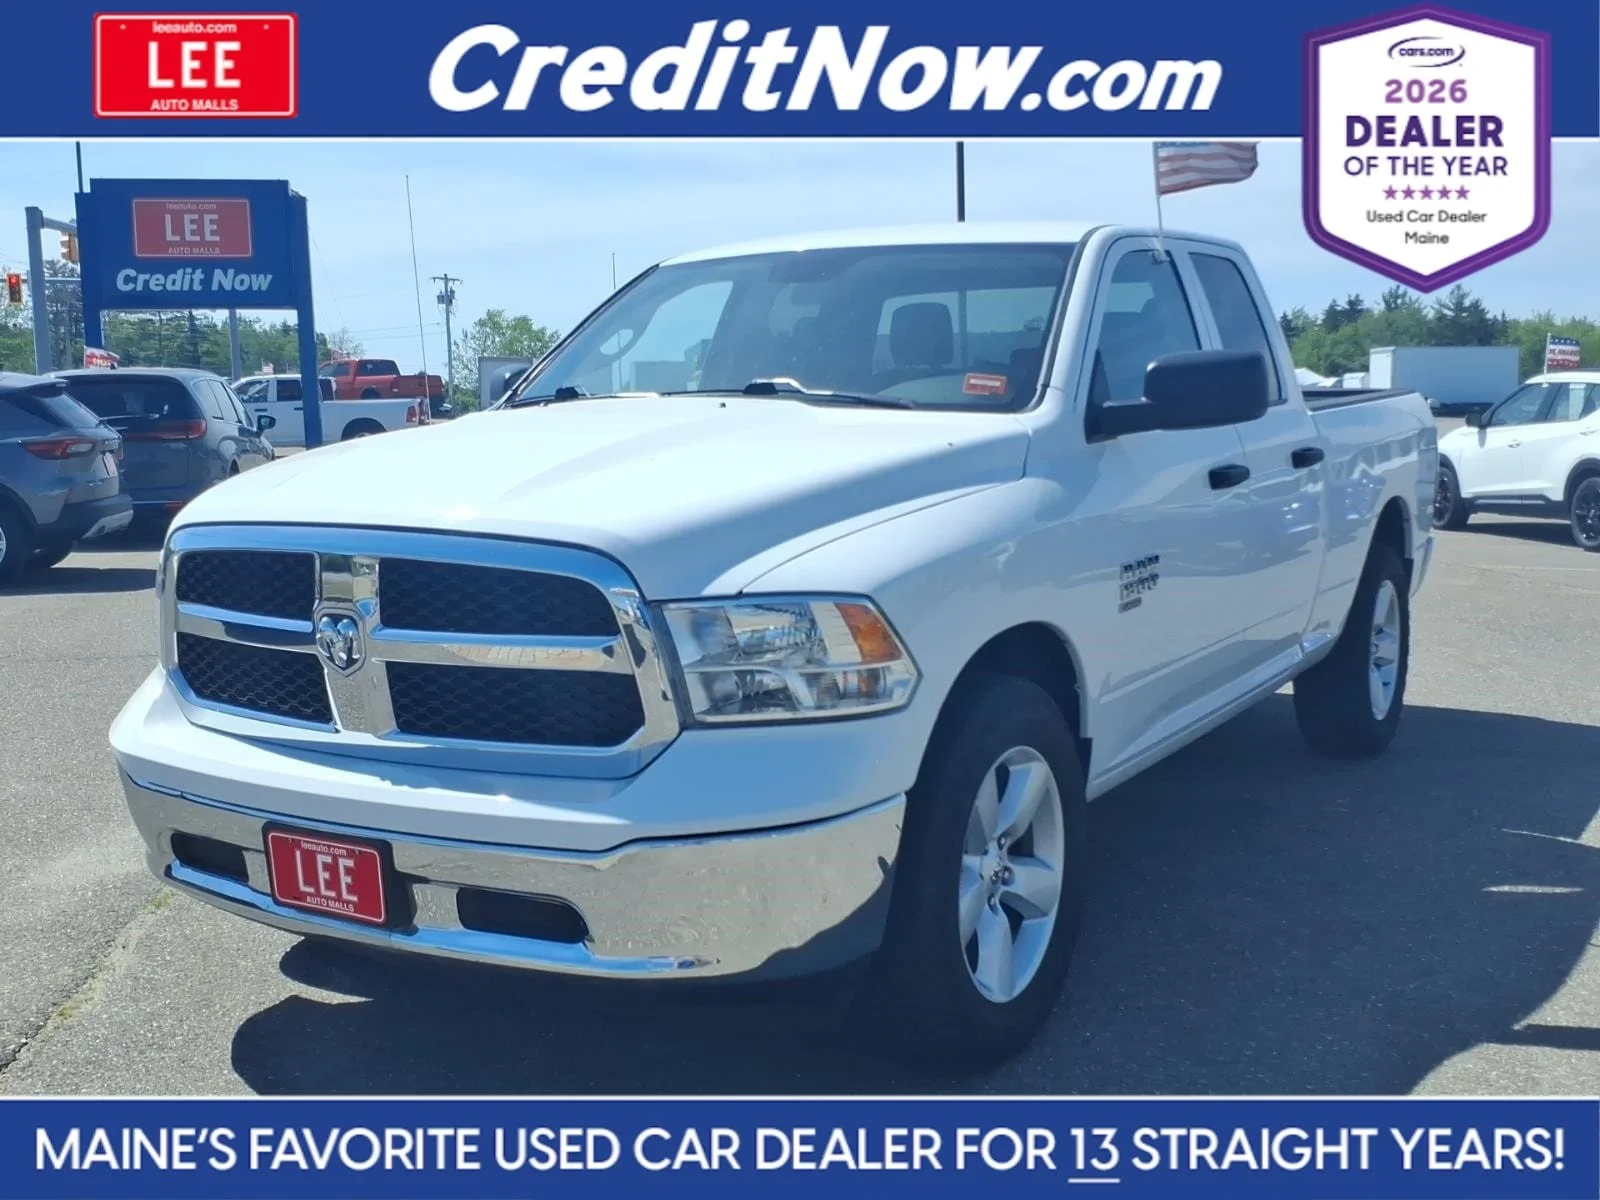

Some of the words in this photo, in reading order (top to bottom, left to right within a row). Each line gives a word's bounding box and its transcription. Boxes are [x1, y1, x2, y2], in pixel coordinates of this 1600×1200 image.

[164, 213, 221, 242] LEE
[168, 247, 192, 255] AUTO
[193, 247, 221, 255] MALLS
[116, 267, 205, 292] Credit
[211, 268, 273, 291] Now
[301, 840, 347, 856] leeauto.com
[295, 849, 359, 902] LEE
[306, 895, 328, 907] AUTO
[328, 900, 355, 912] MALLS
